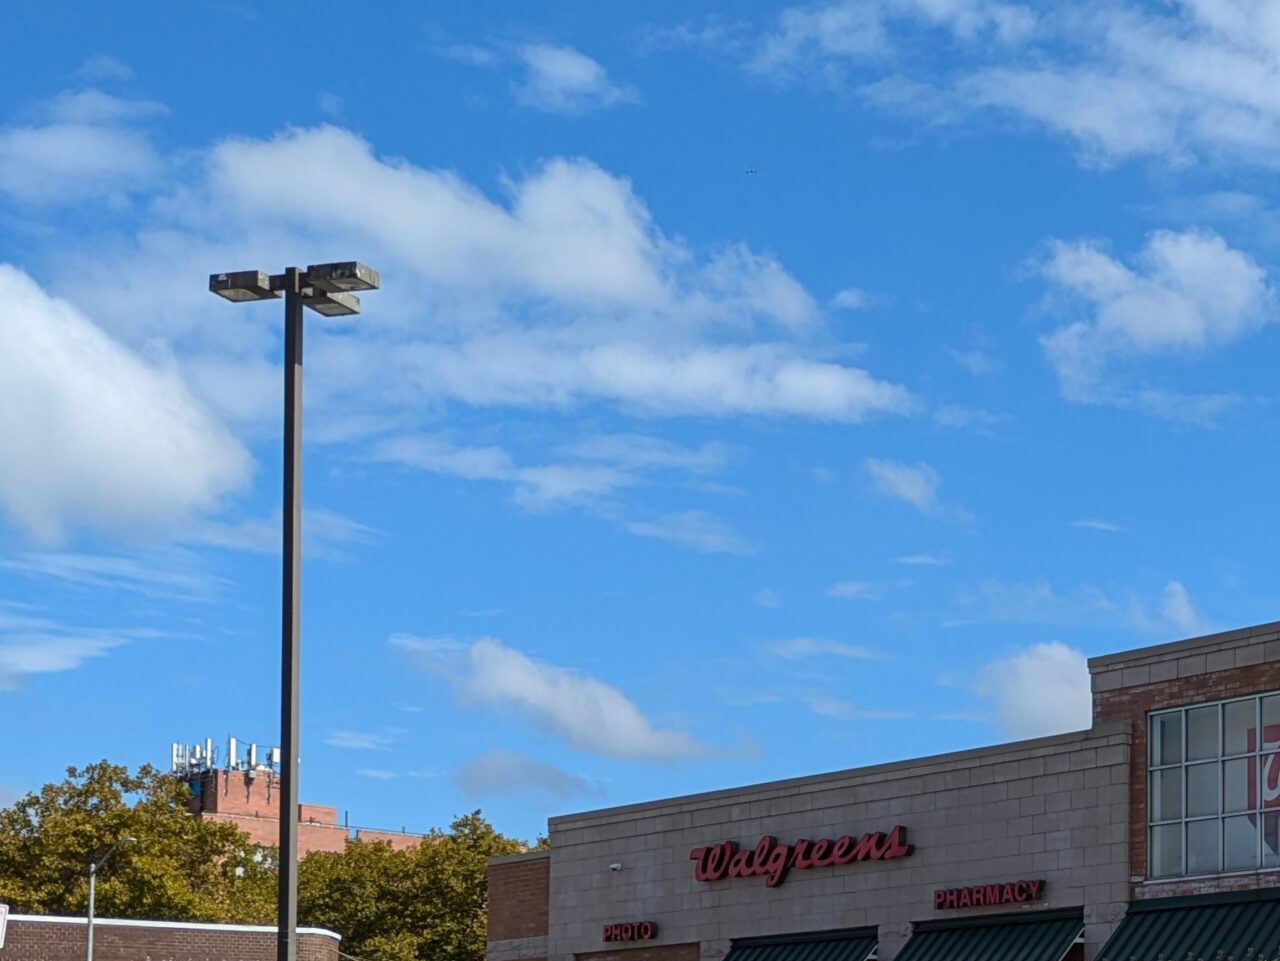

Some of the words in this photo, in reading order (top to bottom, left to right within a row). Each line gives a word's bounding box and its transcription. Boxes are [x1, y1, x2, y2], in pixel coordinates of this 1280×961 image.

[690, 825, 911, 888] Walgreens
[934, 880, 1043, 910] PHARMACY
[602, 921, 653, 943] PHOTO
